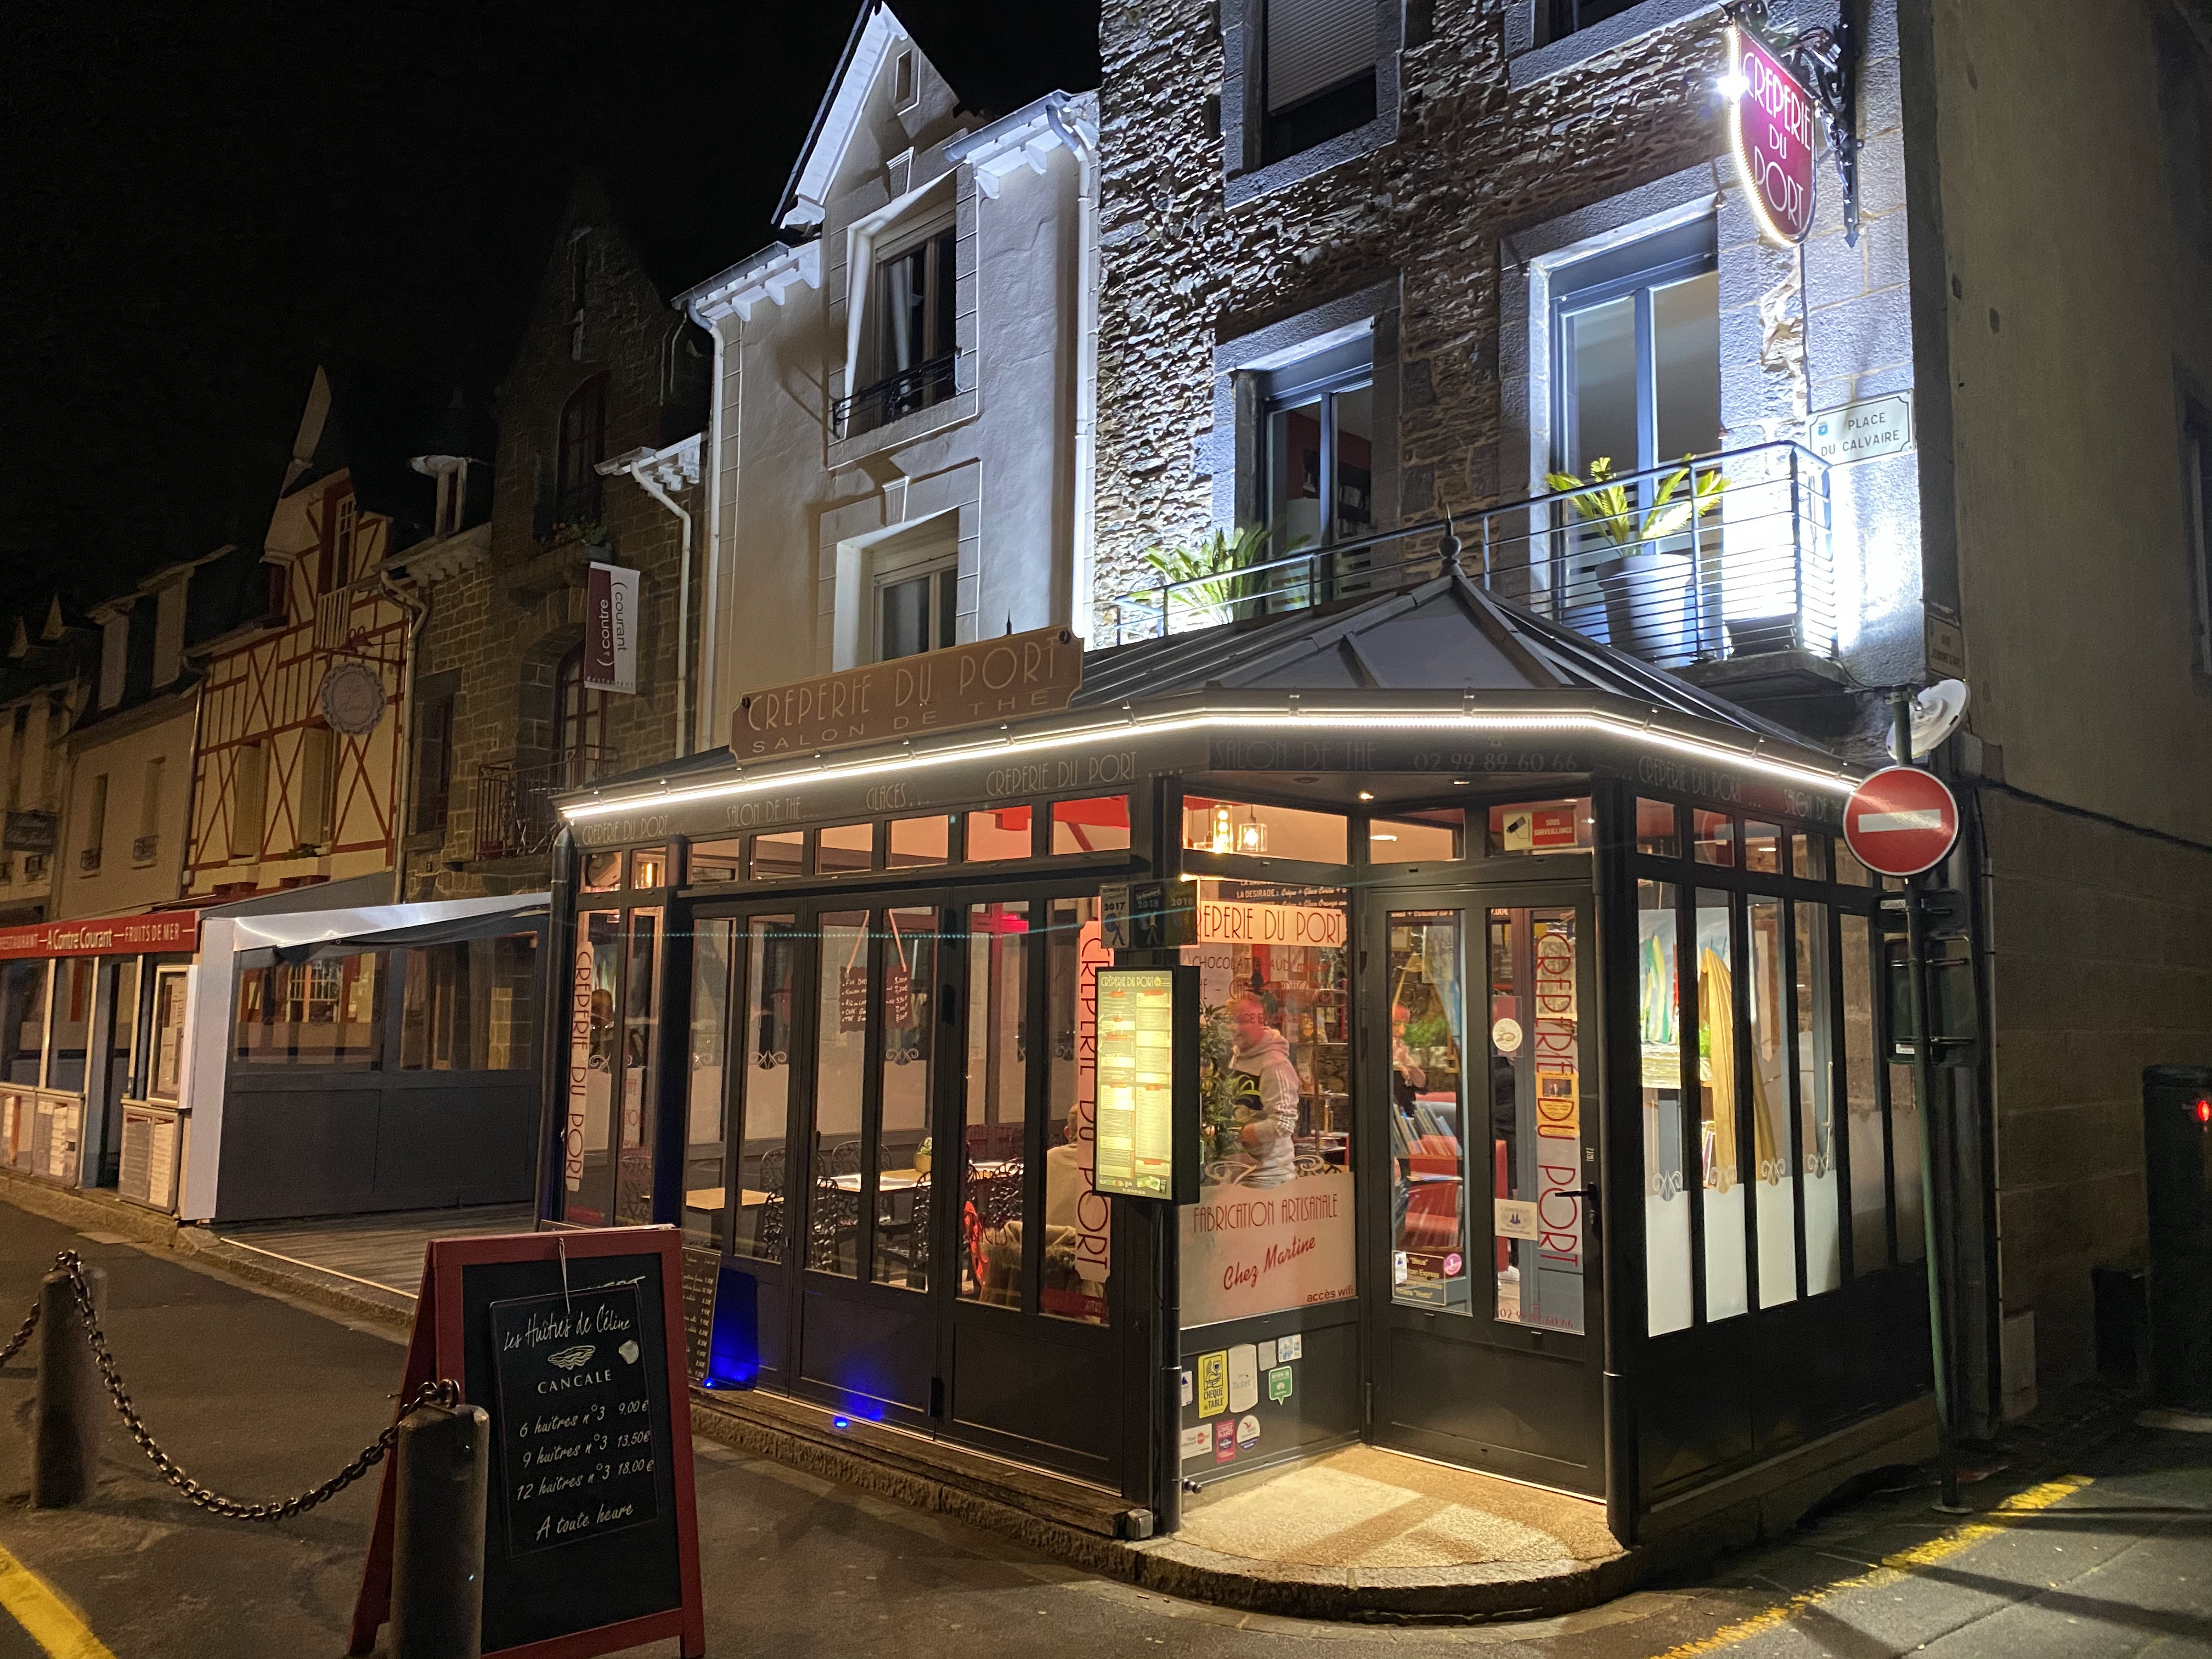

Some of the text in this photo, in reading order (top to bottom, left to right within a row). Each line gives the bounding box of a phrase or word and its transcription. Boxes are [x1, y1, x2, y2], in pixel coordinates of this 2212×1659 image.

[1743, 52, 1810, 150] CREPERIE
[1769, 123, 1787, 160] DU
[1755, 145, 1803, 229] PORT
[1848, 413, 1886, 430] PLACE
[1821, 430, 1899, 456] DU CALVAIRE
[599, 599, 610, 649] contre
[615, 592, 628, 652] courant
[748, 636, 1057, 731] CREPERIE DU PORT
[752, 690, 1048, 753] SALON DE THE
[1216, 740, 1376, 770] SALON DE THE
[1414, 753, 1576, 771] 02 99 89 60 66
[986, 752, 1136, 795] CREPERIE DU PORT
[1638, 755, 1686, 792] CREPERIE
[1692, 769, 1707, 795] DU
[726, 805, 760, 828] SALON
[766, 802, 780, 821] DE
[582, 822, 619, 845] CREPERIE
[623, 819, 636, 840] DU
[1534, 827, 1573, 836] SURVEILLANCE
[1104, 902, 1125, 911] 2017
[1138, 899, 1159, 909] 2018
[47, 930, 53, 950] A
[54, 929, 79, 950] Contre
[80, 928, 113, 949] Courant
[125, 925, 150, 942] FRUITS
[152, 924, 162, 941] DE
[163, 923, 179, 940] MER
[1265, 910, 1285, 940] DU
[1296, 911, 1342, 944] PORT
[1193, 956, 1251, 969] CHOCOLAT
[1136, 976, 1154, 987] PORT
[1534, 934, 1574, 1075] CREPERIE
[566, 951, 592, 1181] CREPERIE DU PORT
[1538, 1098, 1575, 1141] DU
[1194, 1194, 1338, 1233] FABRICATION ARTISANALE
[1538, 1164, 1578, 1267] PORT
[1223, 1235, 1316, 1290] Chez Martine
[1307, 1285, 1353, 1302] accès wifi
[504, 1303, 631, 1351] Les Huîtres de Céline
[1500, 1308, 1512, 1319] 02
[537, 1370, 612, 1394] CANCALE
[1208, 1397, 1224, 1409] TABLE
[520, 1423, 528, 1437] 6
[523, 1452, 531, 1468] 9
[517, 1484, 532, 1500] 12
[536, 1503, 633, 1541] A toute heure
